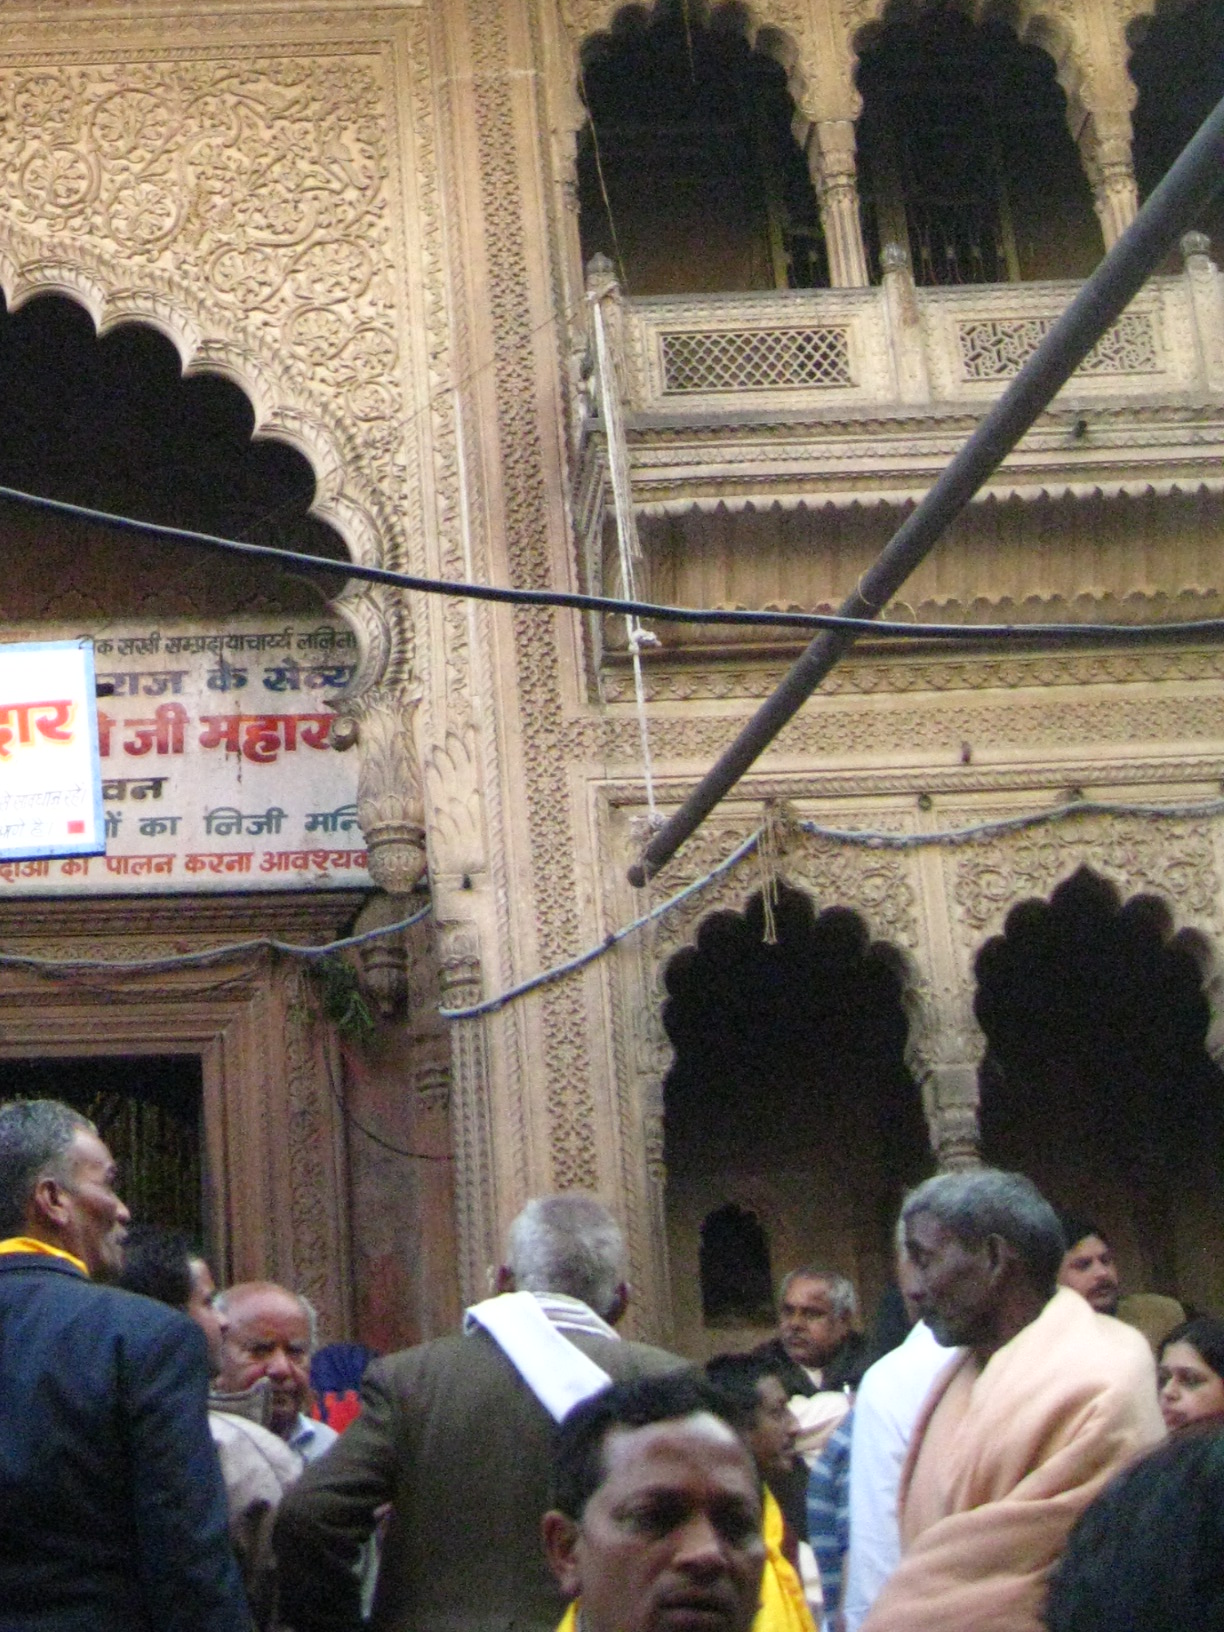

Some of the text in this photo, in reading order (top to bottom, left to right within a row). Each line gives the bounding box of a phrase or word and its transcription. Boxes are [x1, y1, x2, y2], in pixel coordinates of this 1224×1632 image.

[206, 658, 247, 692] के
[123, 701, 190, 757] जी
[139, 816, 183, 837] का
[203, 806, 289, 836] निजी
[102, 853, 177, 876] पालन
[184, 851, 255, 874] करना
